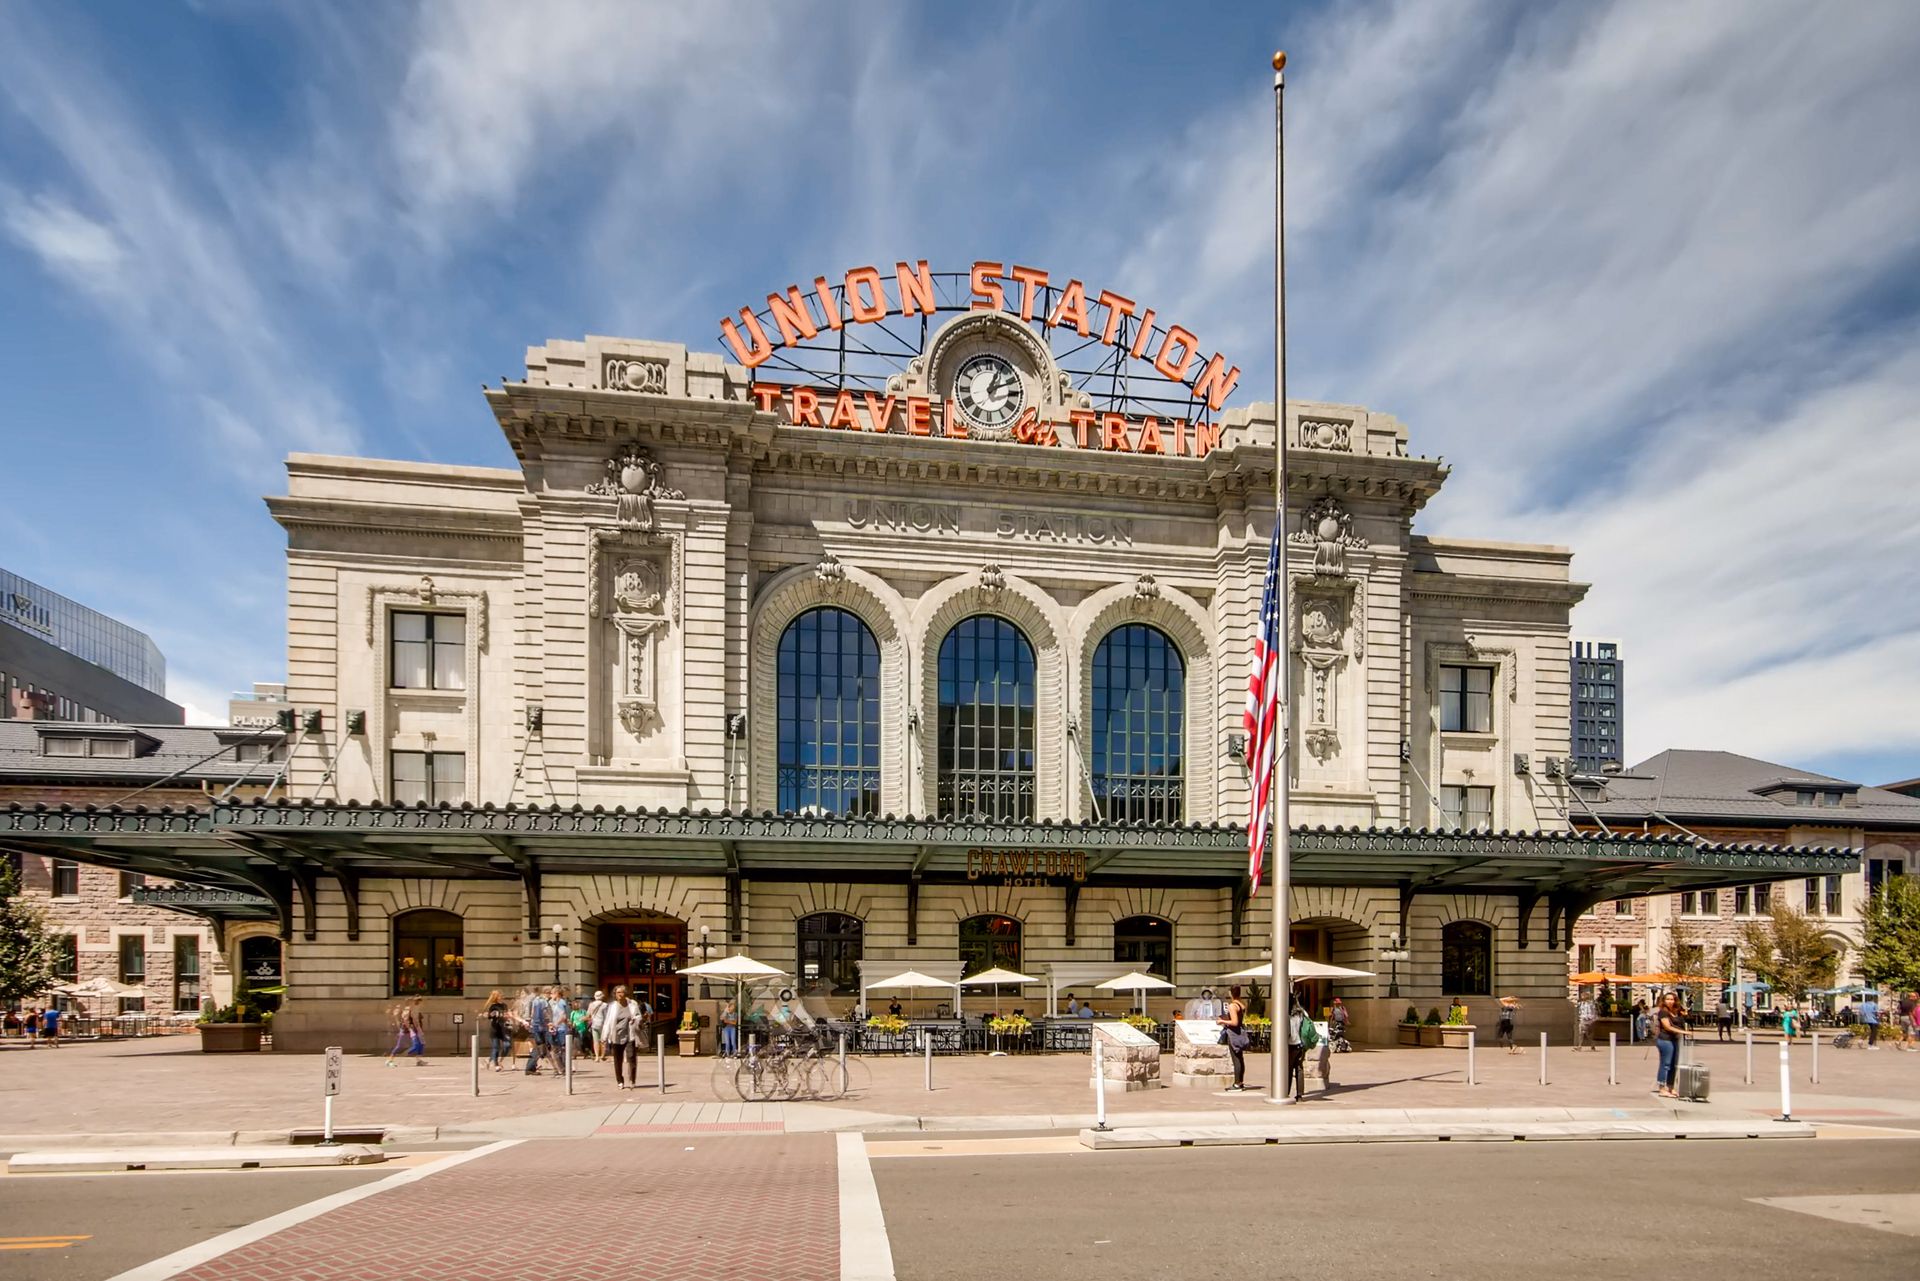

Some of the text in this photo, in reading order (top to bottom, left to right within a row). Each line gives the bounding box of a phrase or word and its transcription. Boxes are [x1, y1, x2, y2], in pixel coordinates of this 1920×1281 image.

[719, 260, 1241, 411] UNION STATION
[752, 384, 968, 438] TRAVEL
[1069, 410, 1220, 458] TRAIN
[847, 499, 1134, 547] UNION STATION
[233, 715, 277, 726] PLATF
[967, 849, 1086, 881] CRAWFORD
[1004, 878, 1051, 887] HOTEL
